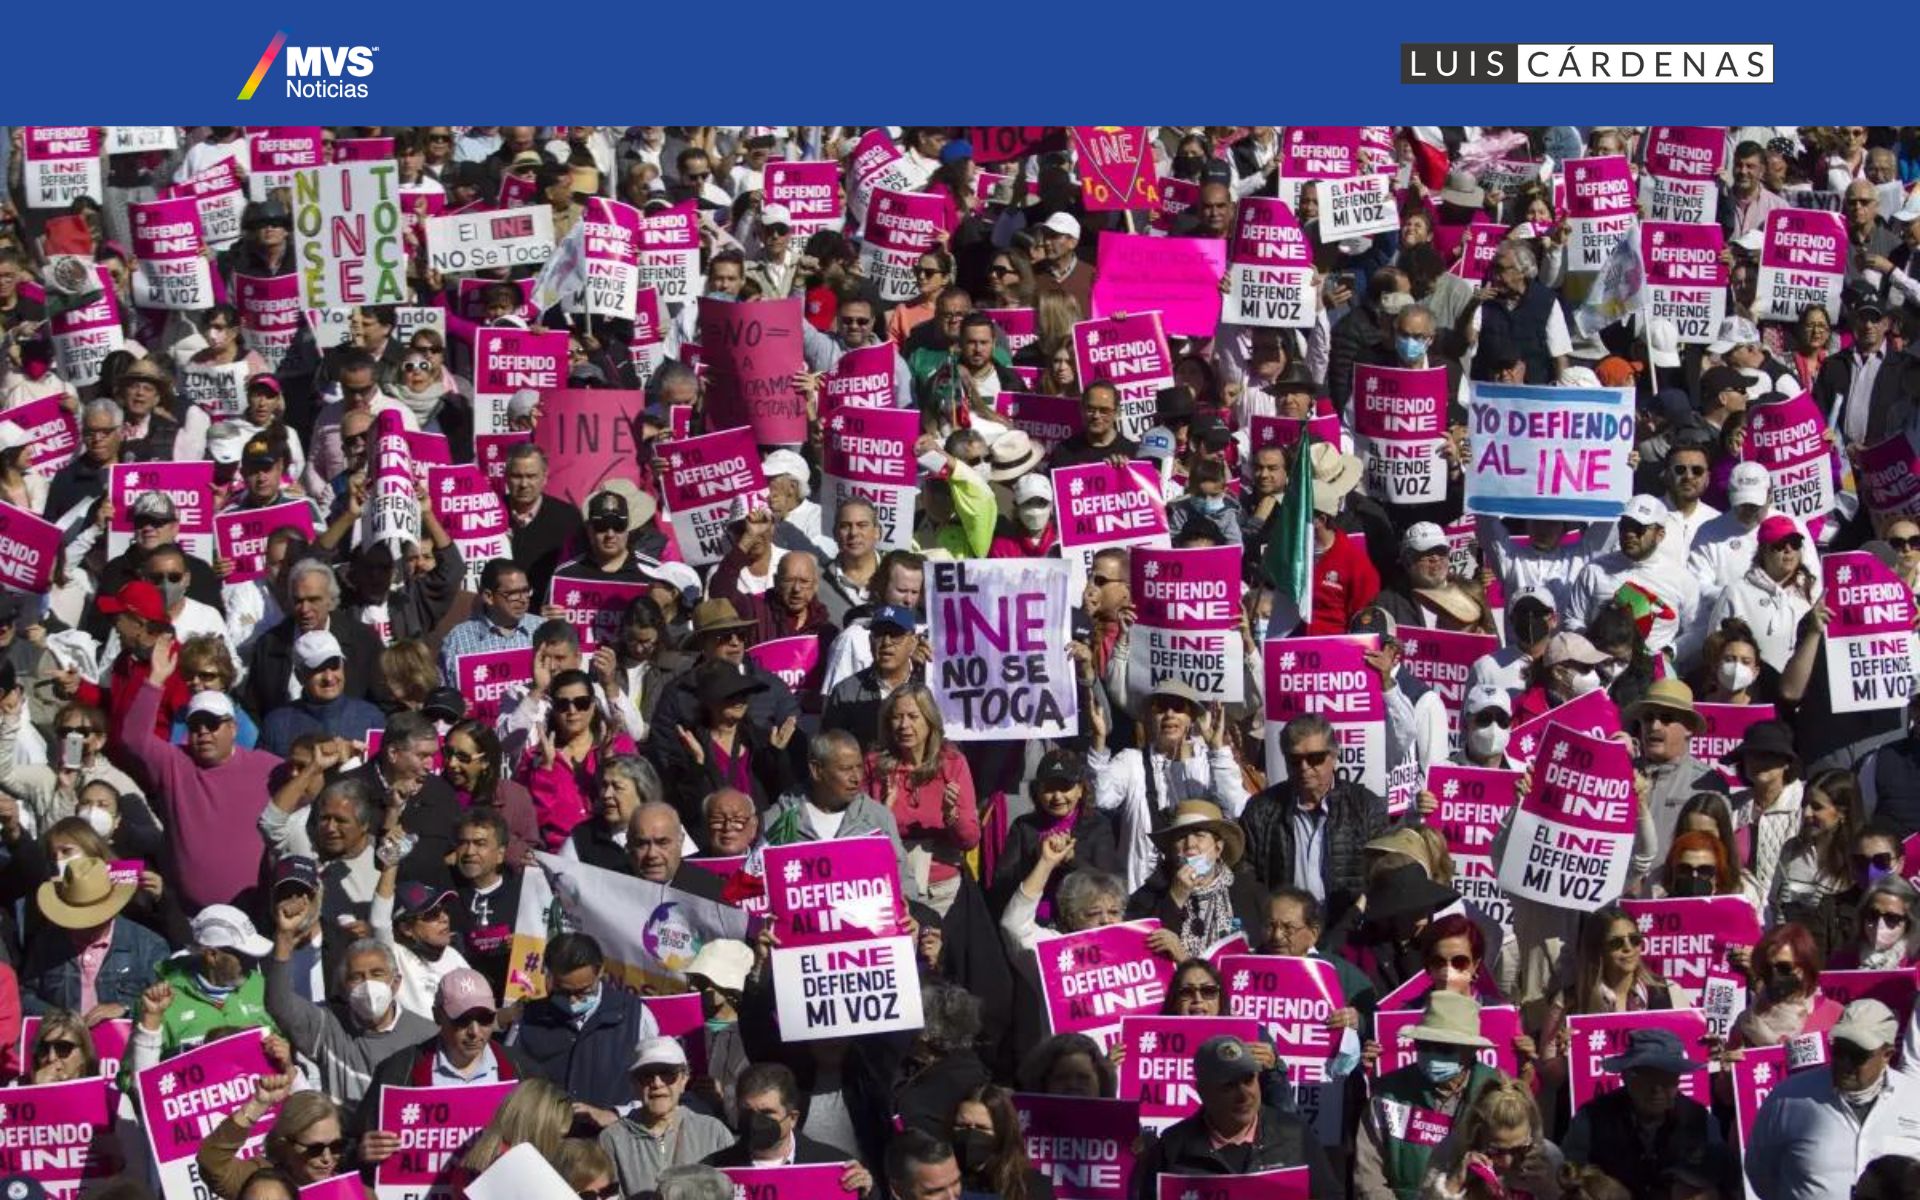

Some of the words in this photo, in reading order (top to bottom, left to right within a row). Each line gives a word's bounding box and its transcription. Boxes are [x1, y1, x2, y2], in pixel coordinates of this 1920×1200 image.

[48, 141, 91, 153] INE
[258, 138, 312, 151] DEFIENDO
[1089, 133, 1136, 167] INE
[1292, 145, 1349, 158] DEFIENDO
[1656, 143, 1712, 161] DEFIENDO
[53, 162, 88, 173] INE
[274, 152, 316, 165] INE
[1306, 160, 1349, 173] INE
[1669, 159, 1712, 175] INE
[41, 188, 57, 201] MI
[773, 185, 831, 199] DEFIENDO
[1344, 177, 1380, 193] INE
[1576, 180, 1628, 196] DEFIENDO
[1669, 182, 1706, 195] INE
[789, 200, 832, 213] INE
[1593, 196, 1631, 210] INE
[1333, 211, 1350, 227] MI
[1353, 206, 1384, 225] VOZ
[138, 224, 194, 239] DEFIENDO
[331, 169, 367, 303] INE
[370, 166, 403, 303] TOCA
[460, 224, 478, 242] El
[491, 215, 534, 241] INE
[644, 229, 690, 244] INE
[1242, 225, 1303, 241] DEFIENDO
[1582, 222, 1595, 234] EL
[154, 238, 199, 253] INE
[1774, 232, 1835, 250] DEFIENDO
[433, 251, 466, 269] NO
[471, 249, 498, 266] Se
[649, 254, 687, 265] INE
[1257, 243, 1306, 260] INE
[1651, 248, 1716, 264] DEFIENDO
[1789, 250, 1836, 265] INE
[159, 262, 198, 275] INE
[1242, 269, 1255, 283] EL
[1259, 271, 1302, 285] INE
[1669, 265, 1718, 279] INE
[1774, 272, 1786, 285] EL
[1789, 274, 1830, 288] INE
[171, 288, 200, 304] VOZ
[1242, 284, 1302, 300] DEFIENDE
[1653, 290, 1665, 302] EL
[1670, 291, 1711, 304] INE
[1773, 285, 1828, 302] DEFIENDE
[67, 305, 111, 324] INE
[1241, 302, 1260, 318] MI
[1267, 302, 1301, 320] VOZ
[1653, 303, 1710, 319] DEFIENDE
[1771, 299, 1790, 315] MI
[1677, 319, 1710, 337] VOZ
[1089, 339, 1156, 364] DEFIENDO
[488, 356, 556, 370] DEFIENDO
[1110, 356, 1162, 377] INE
[506, 373, 557, 387] INE
[827, 372, 889, 395] DEFIENDO
[492, 399, 505, 412] EL
[1365, 395, 1435, 413] DEFIENDO
[1384, 416, 1438, 433] INE
[1472, 404, 1501, 434] YO
[1508, 410, 1633, 441] DEFIENDO
[556, 413, 634, 454] INE
[1754, 419, 1817, 447] DEFIENDO
[832, 436, 904, 457] DEFIENDO
[1385, 444, 1432, 458] INE
[1774, 435, 1821, 462] INE
[674, 456, 746, 487] DEFIENDO
[849, 456, 905, 476] INE
[1368, 458, 1431, 474] DEFIENDE
[1477, 440, 1527, 475] AL
[1536, 448, 1612, 495] INE
[1780, 463, 1820, 484] INE
[698, 471, 754, 498] INE
[1393, 478, 1431, 495] VOZ
[441, 491, 499, 513] DEFIENDO
[851, 486, 898, 504] INE
[1072, 491, 1150, 516] DEFIENDO
[1793, 494, 1823, 517] VOZ
[462, 510, 504, 530] INE
[690, 512, 706, 526] EL
[1096, 509, 1156, 533] INE
[465, 541, 503, 558] INE
[934, 563, 979, 593] EL
[1144, 581, 1227, 600] DEFIENDO
[1837, 583, 1905, 606] DEFIENDO
[1167, 601, 1229, 620] INE
[1863, 603, 1909, 625] INE
[943, 593, 1047, 656] INE
[1150, 633, 1165, 649] EL
[1170, 636, 1225, 650] INE
[1849, 642, 1866, 658] EL
[1871, 638, 1908, 656] INE
[1151, 650, 1225, 670] DEFIENDE
[1851, 656, 1912, 677] DEFIENDE
[942, 656, 988, 689] NO
[1001, 654, 1049, 684] SE
[1280, 671, 1367, 693] DEFIENDO
[1853, 678, 1877, 701] MI
[949, 687, 1066, 729] TOCA
[1305, 692, 1370, 713] INE
[1551, 740, 1595, 770] #YO
[1442, 778, 1485, 799] #YO
[1545, 763, 1630, 800] DEFIENDO
[1561, 794, 1630, 823] INE
[1533, 825, 1552, 844] EL
[1556, 831, 1615, 856] INE
[783, 856, 832, 883] #YO
[1529, 844, 1611, 877] DEFIENDE
[786, 877, 886, 910] DEFIENDO
[1522, 864, 1551, 893] MI
[1558, 873, 1606, 903] VOZ
[792, 914, 818, 934] AL
[801, 955, 822, 974] EL
[827, 946, 894, 971] INE
[1058, 944, 1101, 972] #YO
[803, 969, 896, 998] DEFIENDE
[1062, 959, 1156, 998] DEFIENDO
[1232, 968, 1278, 992] #YO
[1093, 981, 1165, 1017] INE
[1229, 994, 1329, 1022] DEFIENDO
[806, 1000, 837, 1028] MI
[844, 993, 899, 1023] VOZ
[1138, 1030, 1186, 1054] #YO
[158, 1063, 205, 1095] #YO
[1139, 1083, 1163, 1104] AL
[400, 1102, 449, 1125] #YO
[173, 1121, 199, 1146] AL
[21, 1147, 88, 1171] INE
[401, 1152, 427, 1174] AL
